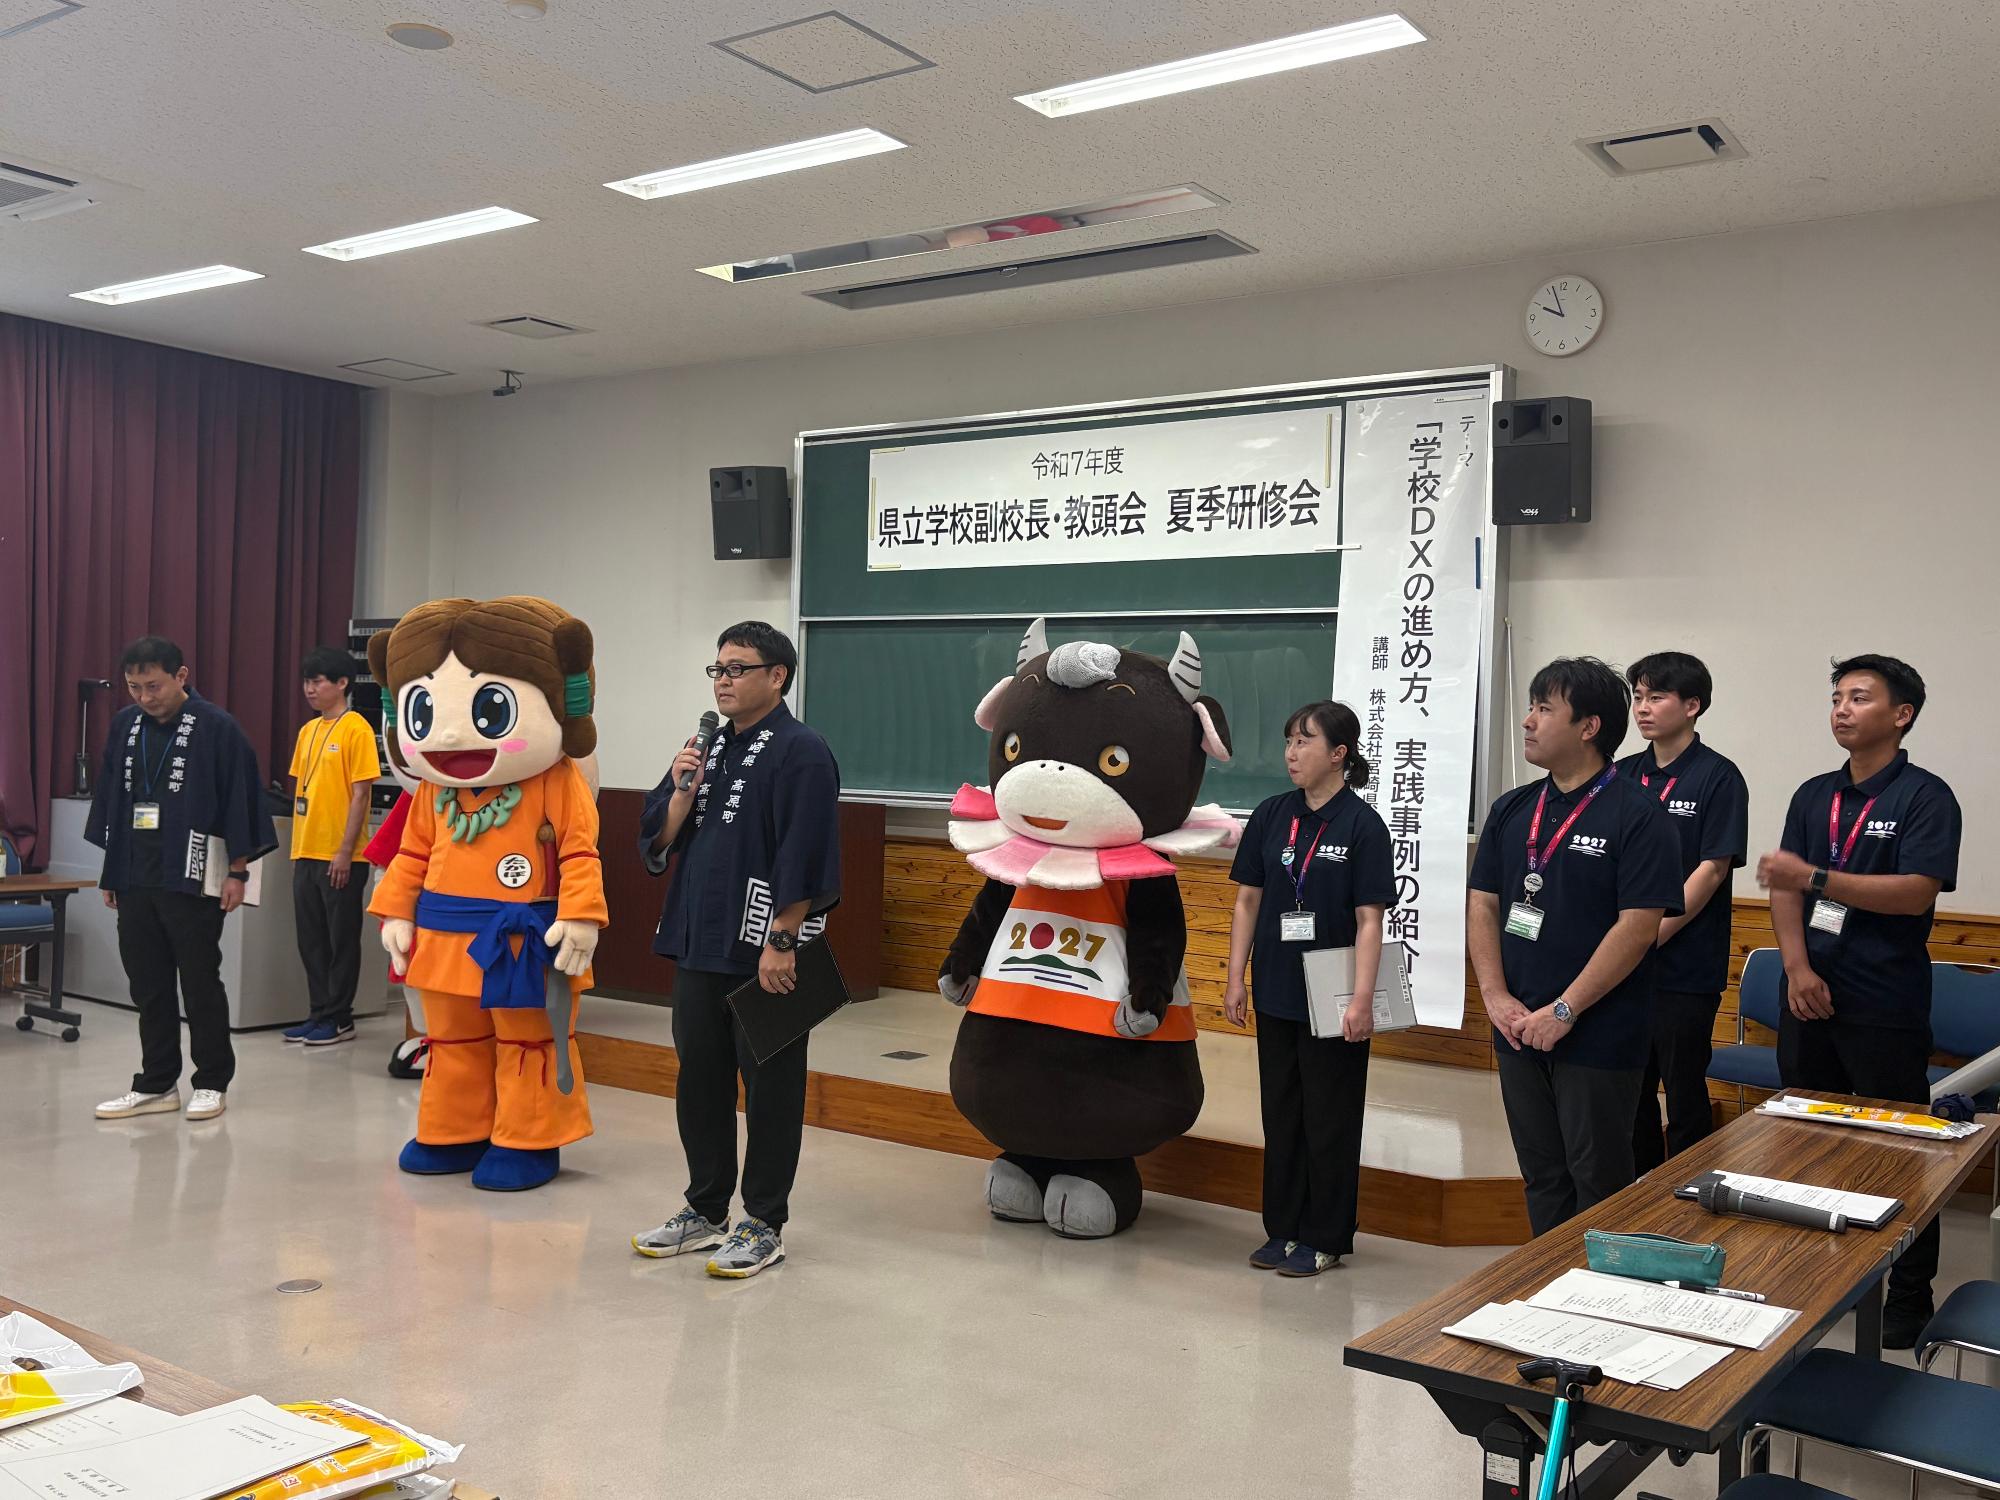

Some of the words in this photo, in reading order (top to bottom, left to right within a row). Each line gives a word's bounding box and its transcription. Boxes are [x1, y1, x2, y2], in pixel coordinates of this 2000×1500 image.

[1560, 281, 1568, 291] 12
[1529, 313, 1537, 324] 9
[1590, 308, 1597, 318] 3
[1558, 339, 1566, 350] 6
[1031, 446, 1125, 481] 令和7年度
[878, 490, 1147, 548] 県立学校副校長・教頭会
[1166, 478, 1322, 535] 夏季研修会
[1371, 636, 1389, 671] 講師
[175, 713, 197, 748] 宮崎県
[741, 729, 774, 767] 宮崎県
[168, 756, 187, 793] 高原町
[721, 778, 747, 824] 高原町
[1669, 800, 1697, 810] 2027
[1319, 844, 1349, 855] 2027
[1572, 834, 1607, 848] 2027
[1009, 922, 1107, 963] 2027
